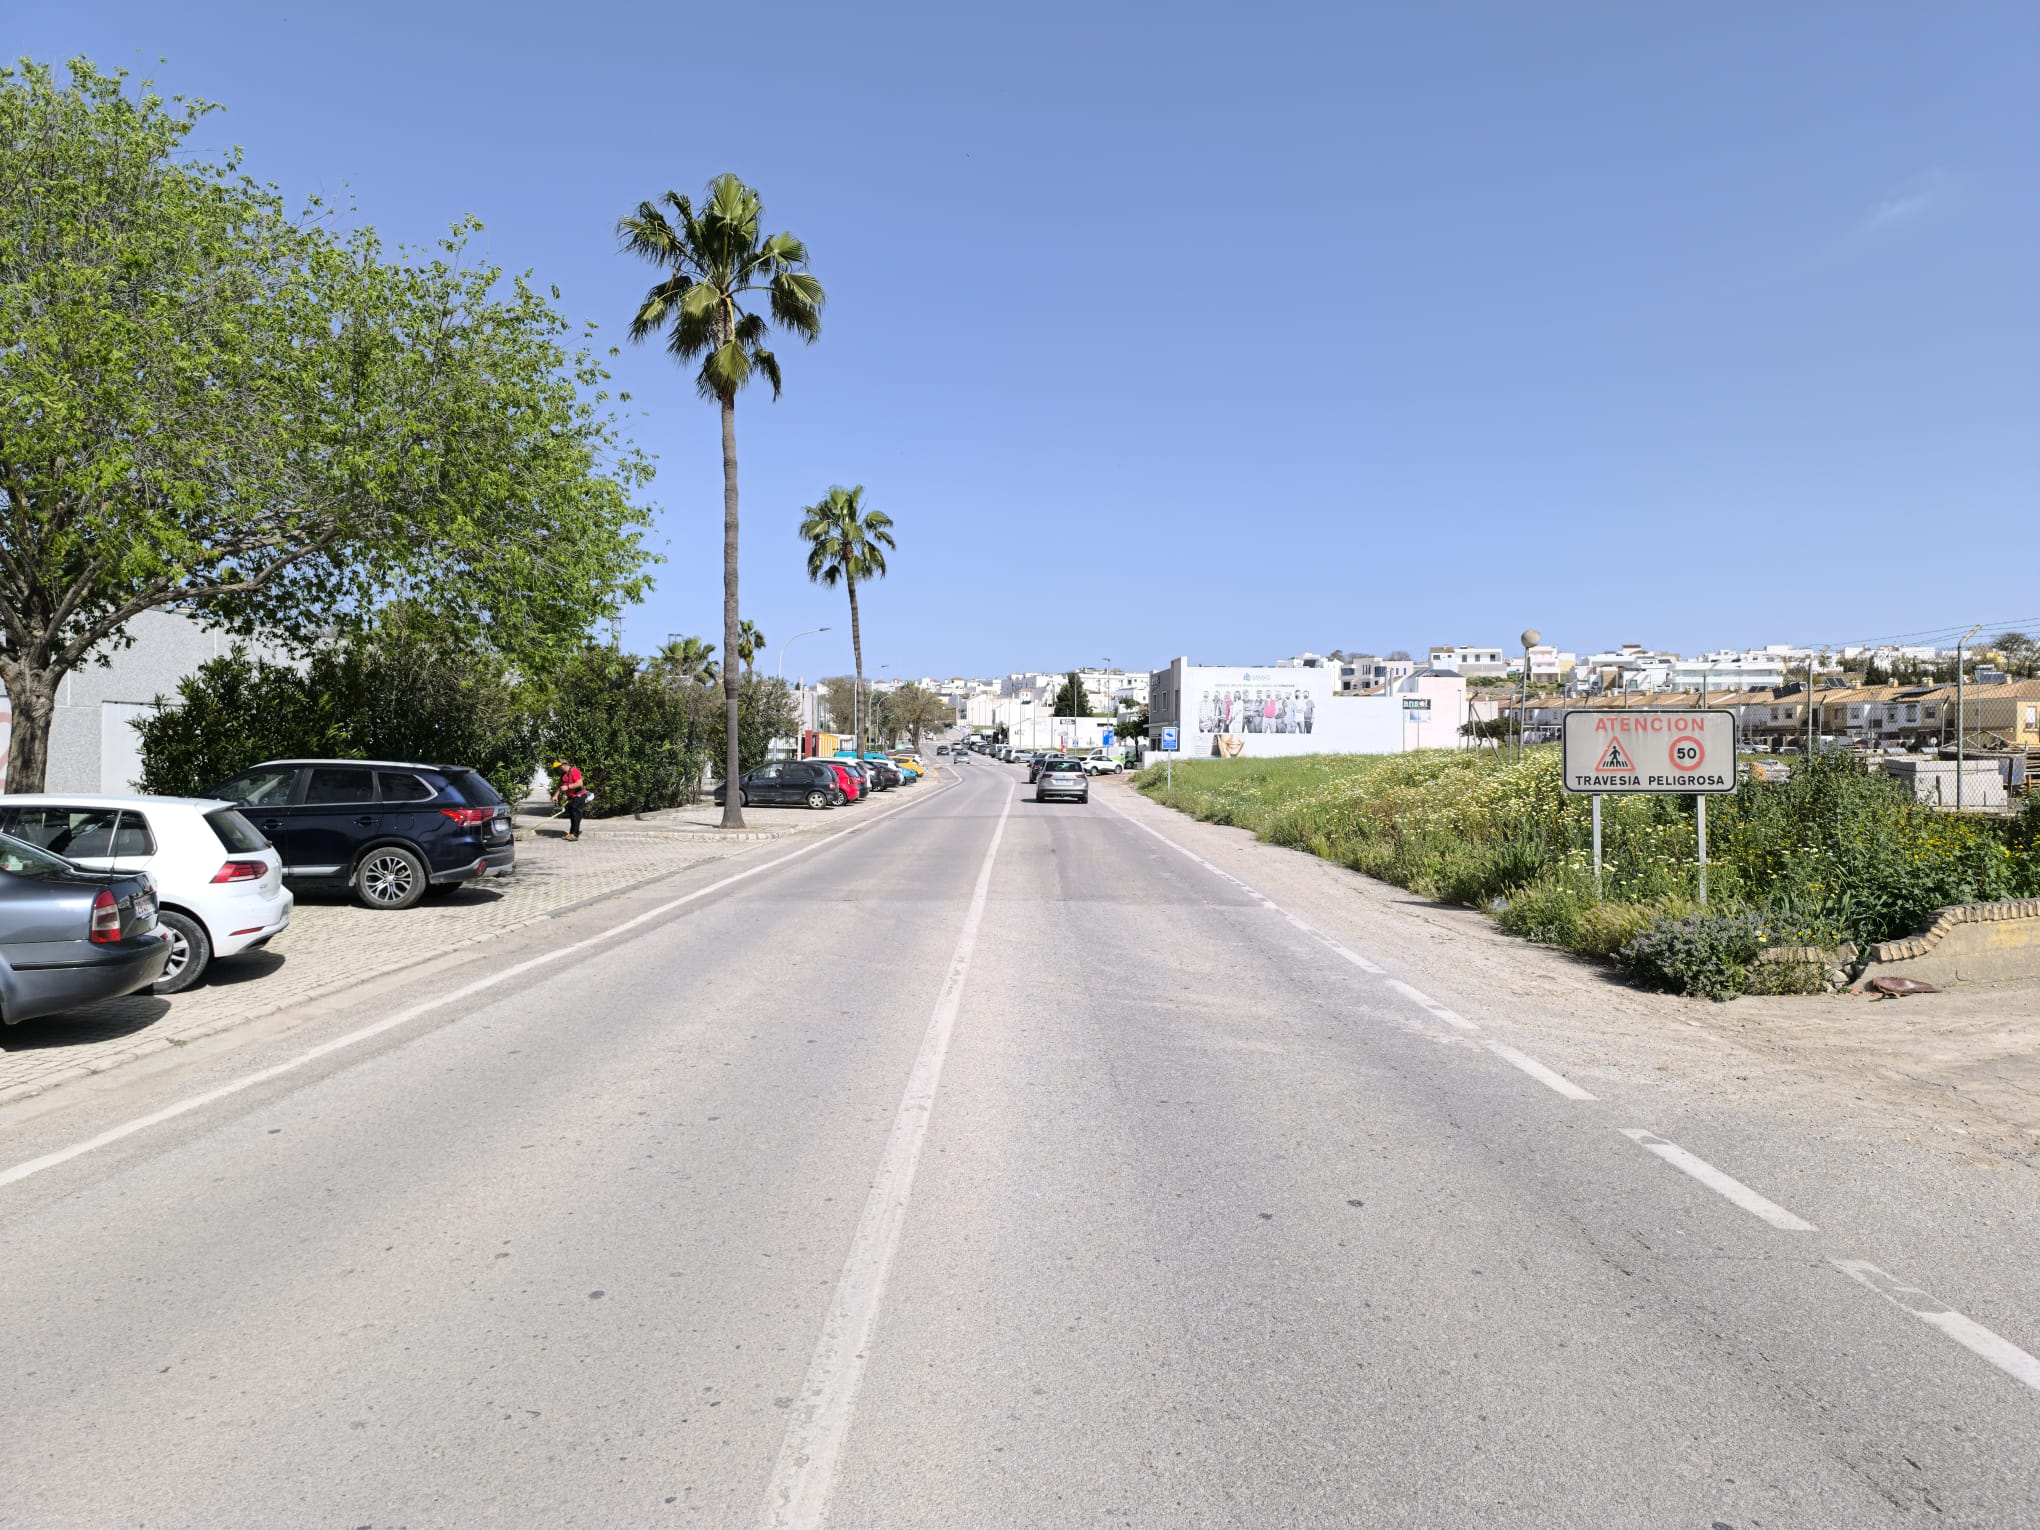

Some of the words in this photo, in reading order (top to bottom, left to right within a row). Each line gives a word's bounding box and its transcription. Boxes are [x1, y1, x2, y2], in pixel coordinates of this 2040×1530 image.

[1595, 717, 1705, 732] ATENCION
[1676, 747, 1697, 760] 50
[1575, 775, 1641, 786] TRAVESIA
[1648, 775, 1725, 786] PELIGROSA
